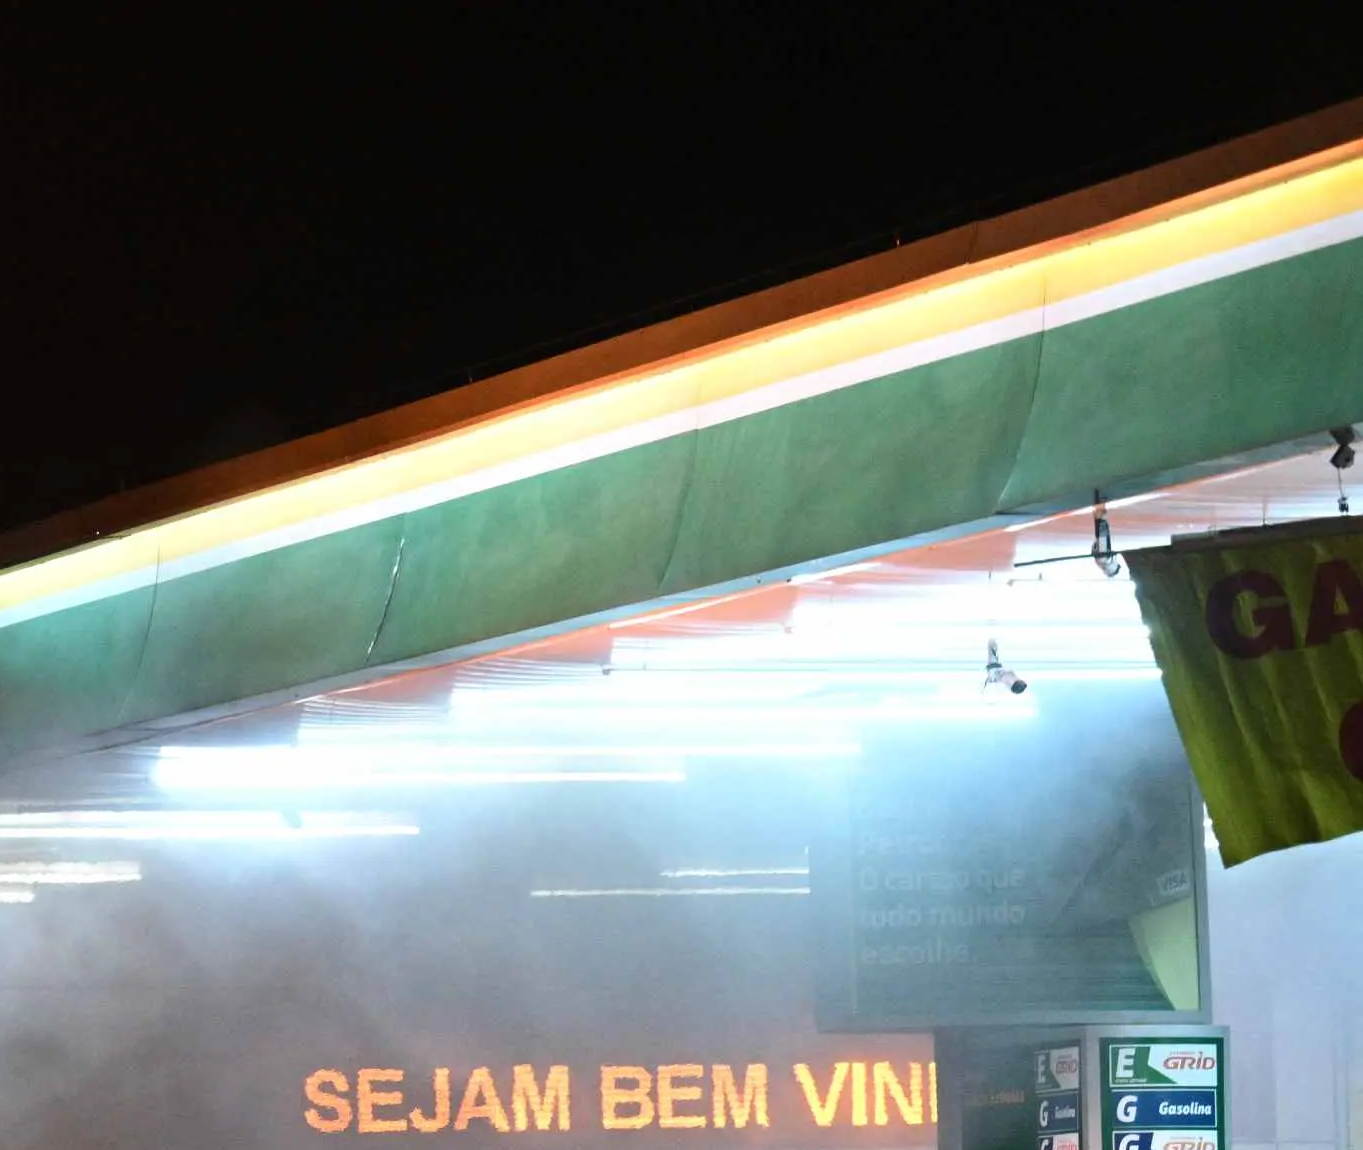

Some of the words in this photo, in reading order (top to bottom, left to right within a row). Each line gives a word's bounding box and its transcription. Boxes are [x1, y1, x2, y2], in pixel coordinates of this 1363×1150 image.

[1115, 1047, 1137, 1078] E
[303, 1064, 571, 1133] SEJAM
[600, 1063, 771, 1130] BEM
[1116, 1095, 1138, 1123] G
[1158, 1101, 1212, 1116] Gasolina
